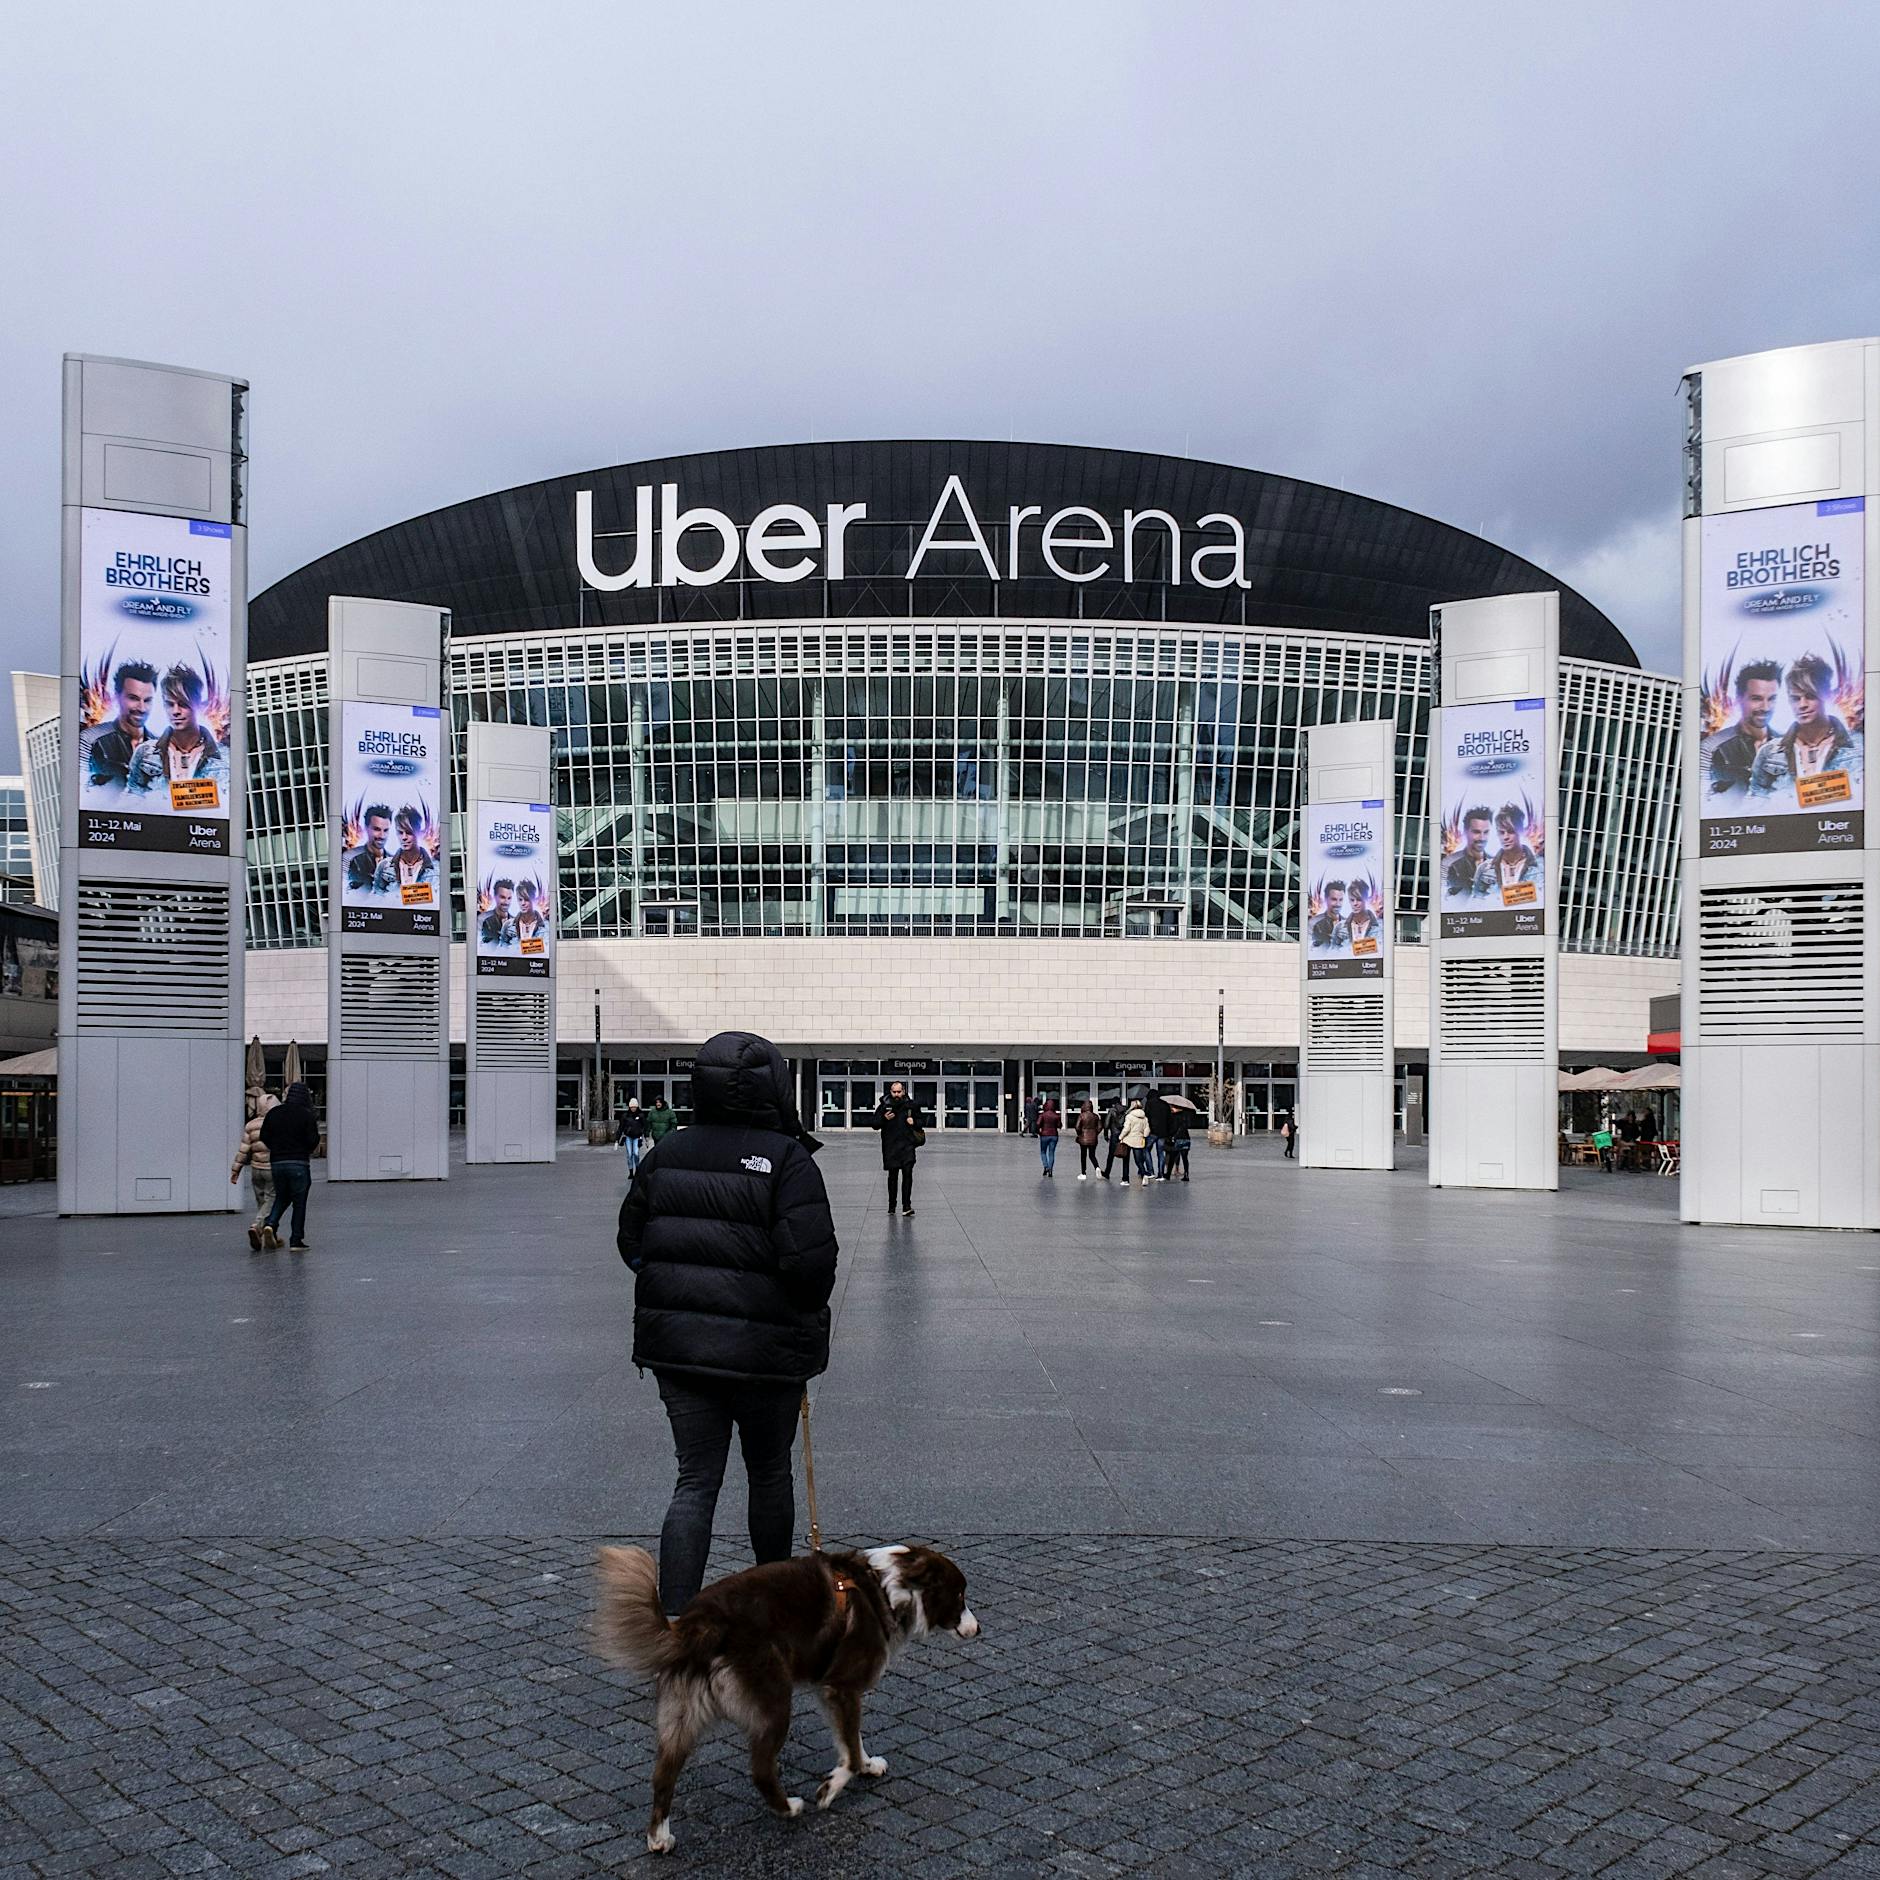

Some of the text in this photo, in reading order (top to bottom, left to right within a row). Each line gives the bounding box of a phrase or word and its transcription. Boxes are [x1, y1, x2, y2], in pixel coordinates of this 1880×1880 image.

[576, 474, 1252, 592] Uber Arena
[1737, 543, 1830, 569] EHRLICH
[116, 551, 201, 576] EHRLICH
[1727, 559, 1840, 587] BROTHERS
[106, 567, 210, 594] BROTHERS
[1743, 593, 1820, 609] DREAM AND FLY
[122, 600, 192, 615] DREAM AND FLY
[364, 730, 421, 745] EHRLICH
[1464, 728, 1523, 744] EHRLICH
[358, 741, 427, 757] BROTHERS
[1457, 739, 1530, 756] BROTHERS
[123, 821, 142, 831] Mai
[189, 824, 218, 836] Uber
[494, 822, 536, 833] EHRLICH
[1324, 822, 1369, 833] EHRLICH
[1746, 824, 1766, 835] Mai
[1818, 820, 1850, 832] Uber
[88, 832, 115, 843] 2024
[489, 830, 540, 842] BROTHERS
[1320, 830, 1373, 842] BROTHERS
[1818, 833, 1854, 844] Arena
[189, 837, 222, 849] Arena
[1709, 839, 1737, 850] 2024
[370, 912, 383, 920] Mai
[413, 914, 432, 923] Uber
[1469, 916, 1482, 924] Mai
[1515, 914, 1536, 923] Uber
[347, 920, 366, 928] 2024
[413, 922, 435, 931] Arena
[1515, 923, 1539, 931] Arena
[676, 1060, 695, 1069] Eing
[894, 1060, 926, 1069] Eingang
[1115, 1061, 1147, 1071] Eingang
[822, 1089, 836, 1108] 1
